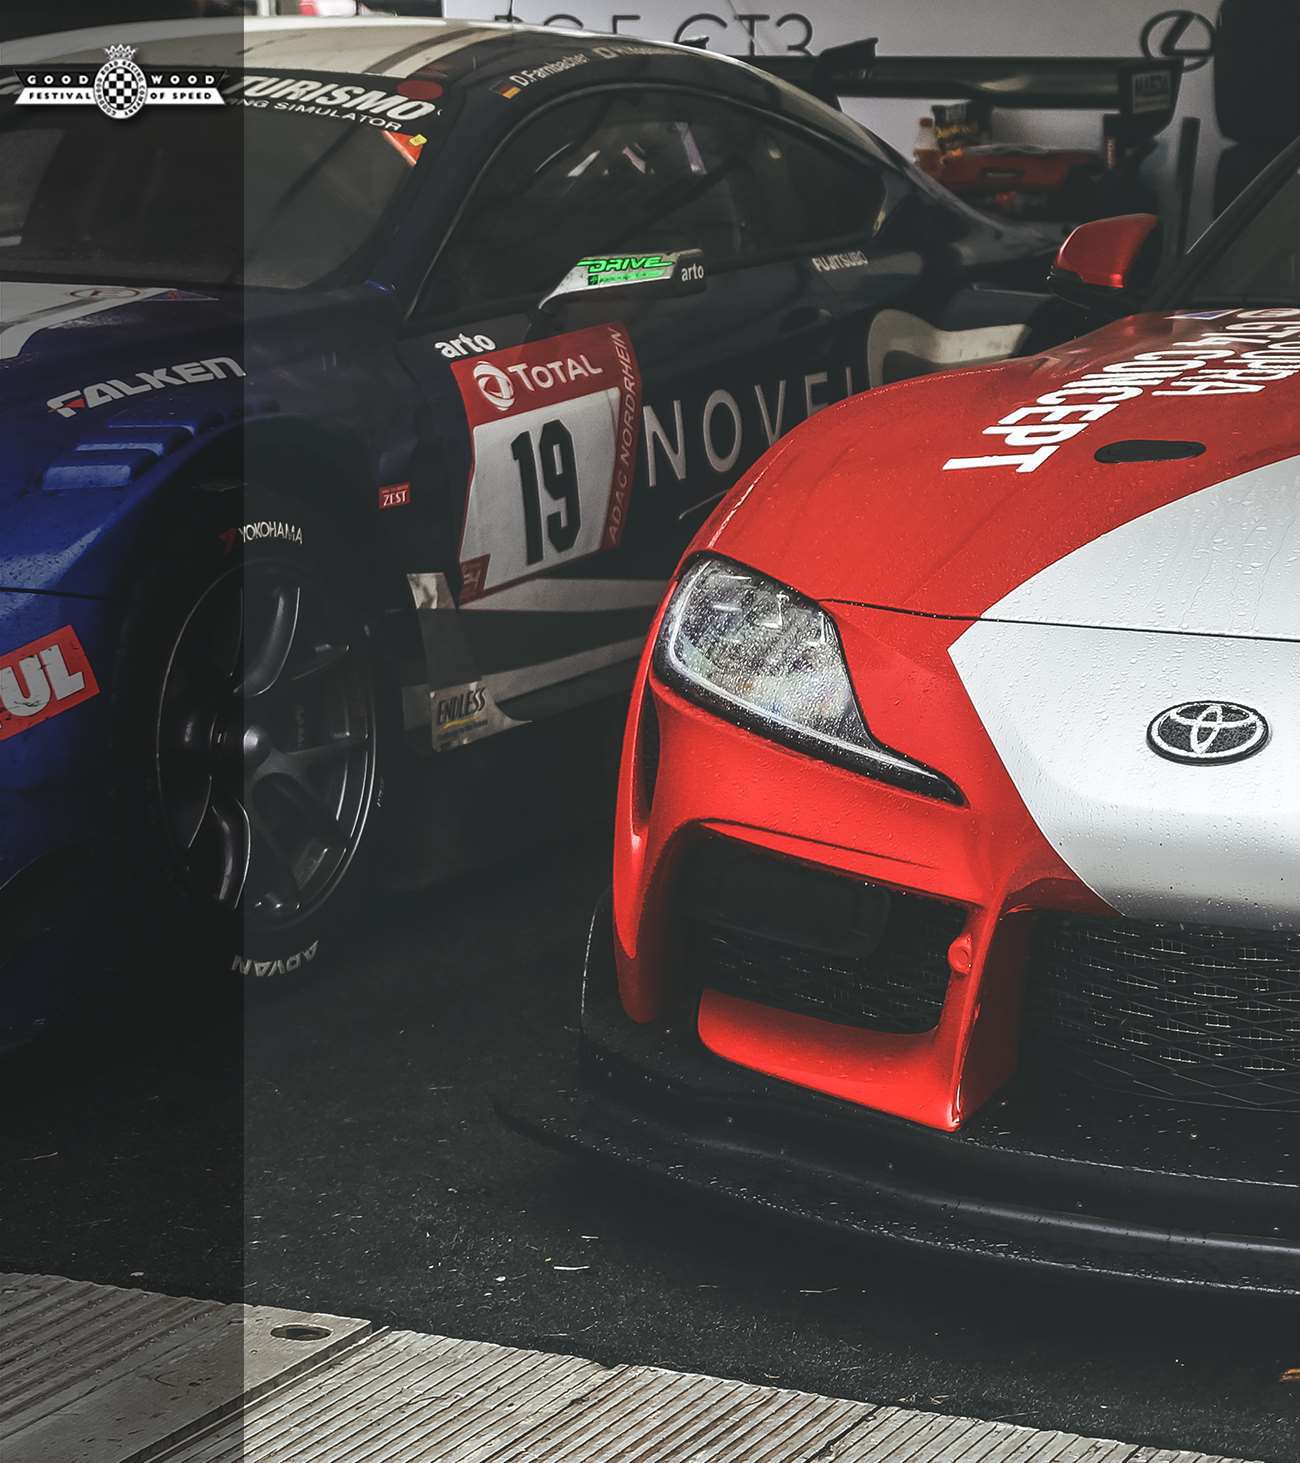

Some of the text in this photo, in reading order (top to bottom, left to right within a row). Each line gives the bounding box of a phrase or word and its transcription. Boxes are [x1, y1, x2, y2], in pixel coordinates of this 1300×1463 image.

[222, 75, 436, 121] TURISMO
[274, 101, 402, 132] SIMULATOR
[577, 256, 674, 274] DRIVE
[681, 263, 705, 282] arto
[435, 333, 497, 359] arto
[47, 356, 248, 418] FALKEN
[508, 354, 604, 392] TOTAL
[942, 349, 1236, 474] CONCEPT
[607, 327, 640, 544] ADAC NORDRHEIN
[510, 419, 582, 566] 19
[238, 521, 303, 544] YOKOHAMA
[231, 939, 320, 977] ADVAN
